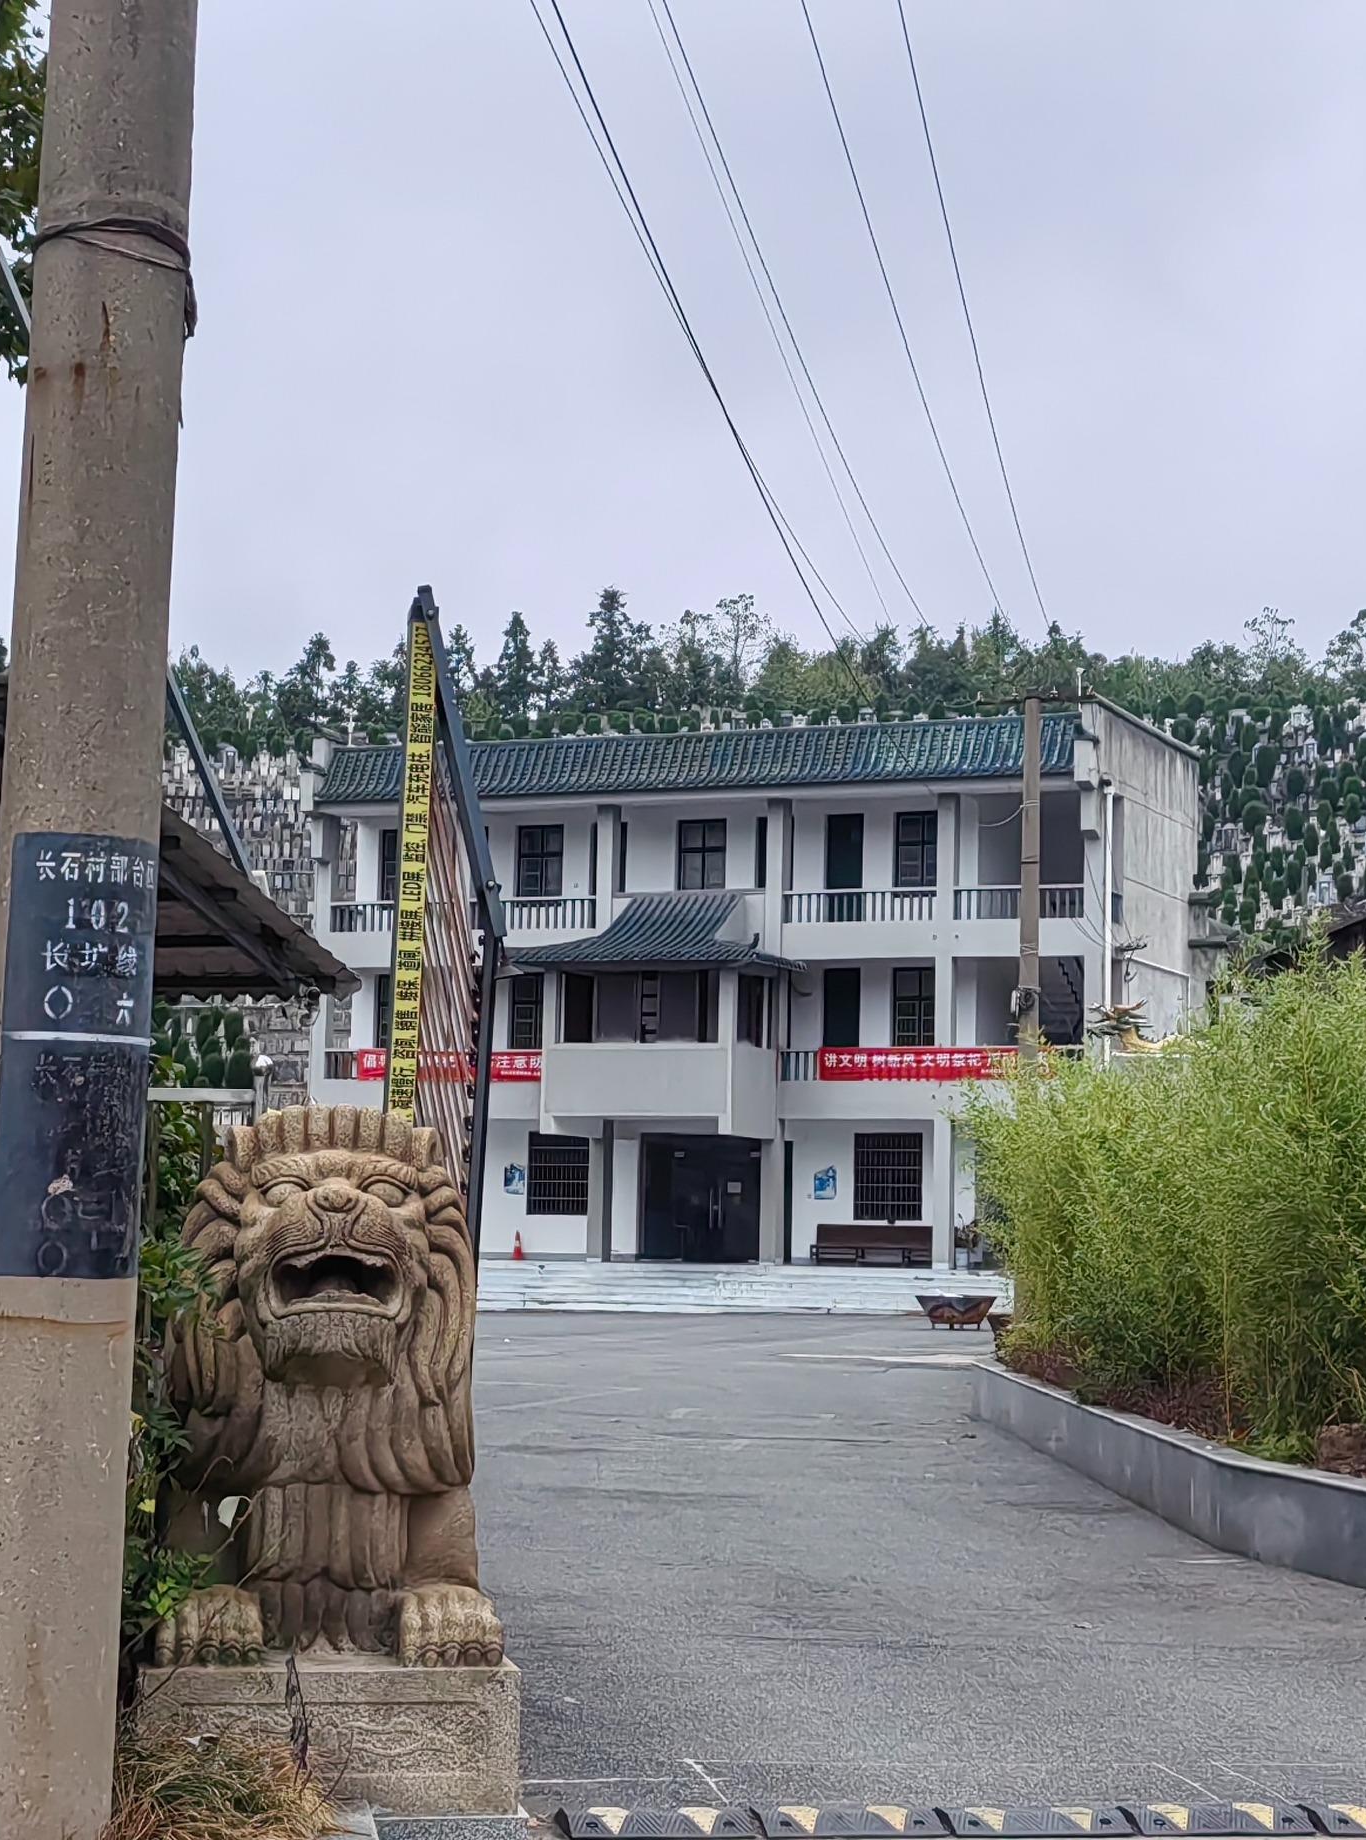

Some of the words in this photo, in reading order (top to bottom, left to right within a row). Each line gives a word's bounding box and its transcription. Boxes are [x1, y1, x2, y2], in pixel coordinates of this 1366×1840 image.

[65, 898, 129, 932] 102
[824, 1053, 867, 1067] 讲文明
[872, 1053, 917, 1067] 树新风
